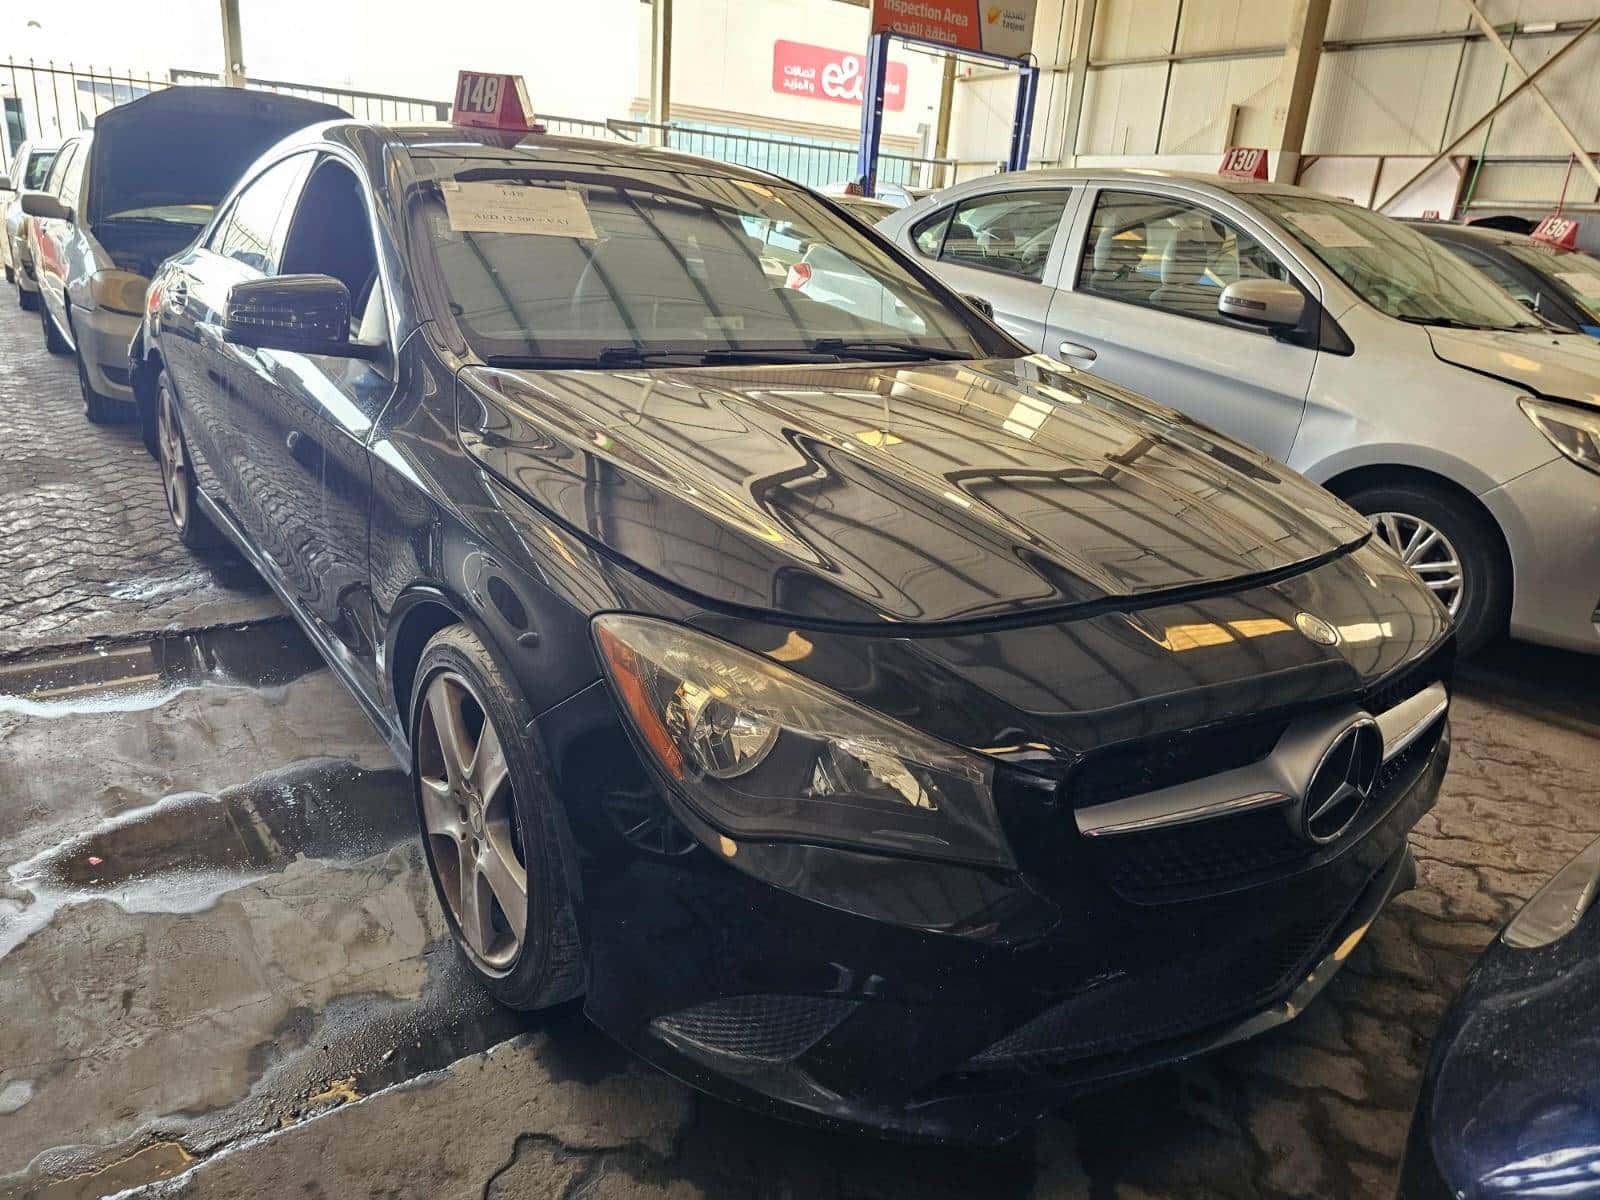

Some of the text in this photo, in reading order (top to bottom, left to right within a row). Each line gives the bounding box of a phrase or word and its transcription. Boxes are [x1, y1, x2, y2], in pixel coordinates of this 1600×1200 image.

[883, 0, 969, 27] Inspection Area
[926, 27, 958, 43] منطقة
[462, 76, 498, 112] 148
[1226, 149, 1258, 171] 130
[1541, 218, 1570, 238] 136
